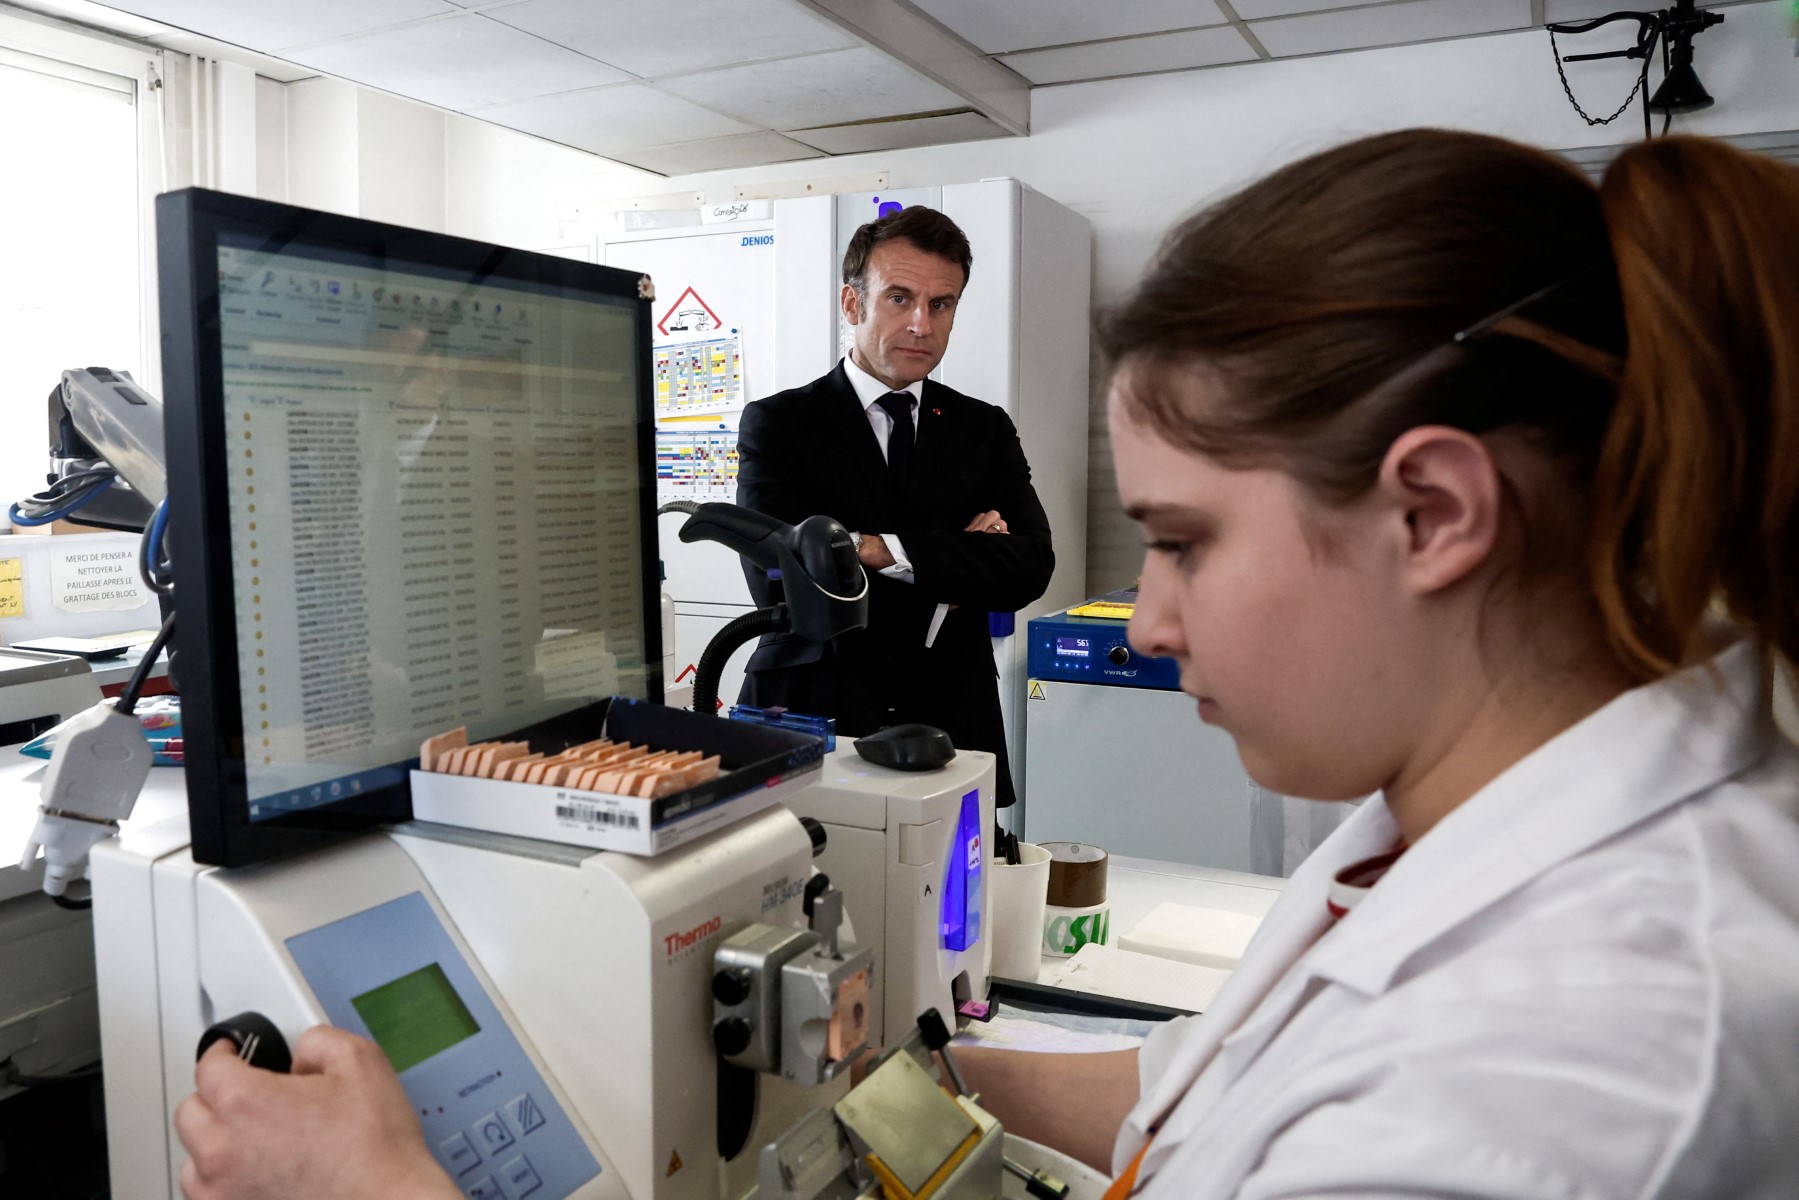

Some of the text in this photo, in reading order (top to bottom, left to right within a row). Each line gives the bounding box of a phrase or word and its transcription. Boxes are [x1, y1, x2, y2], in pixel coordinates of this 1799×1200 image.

[741, 235, 774, 247] DENIOS
[65, 551, 132, 563] MERCI DE PENSER A
[77, 565, 123, 575] NETTOYER LA
[66, 577, 133, 589] PAILLASSE APRES LE
[63, 589, 137, 603] GRATTAGE DES BLOCS
[924, 884, 932, 897] A
[665, 916, 722, 957] Thermo
